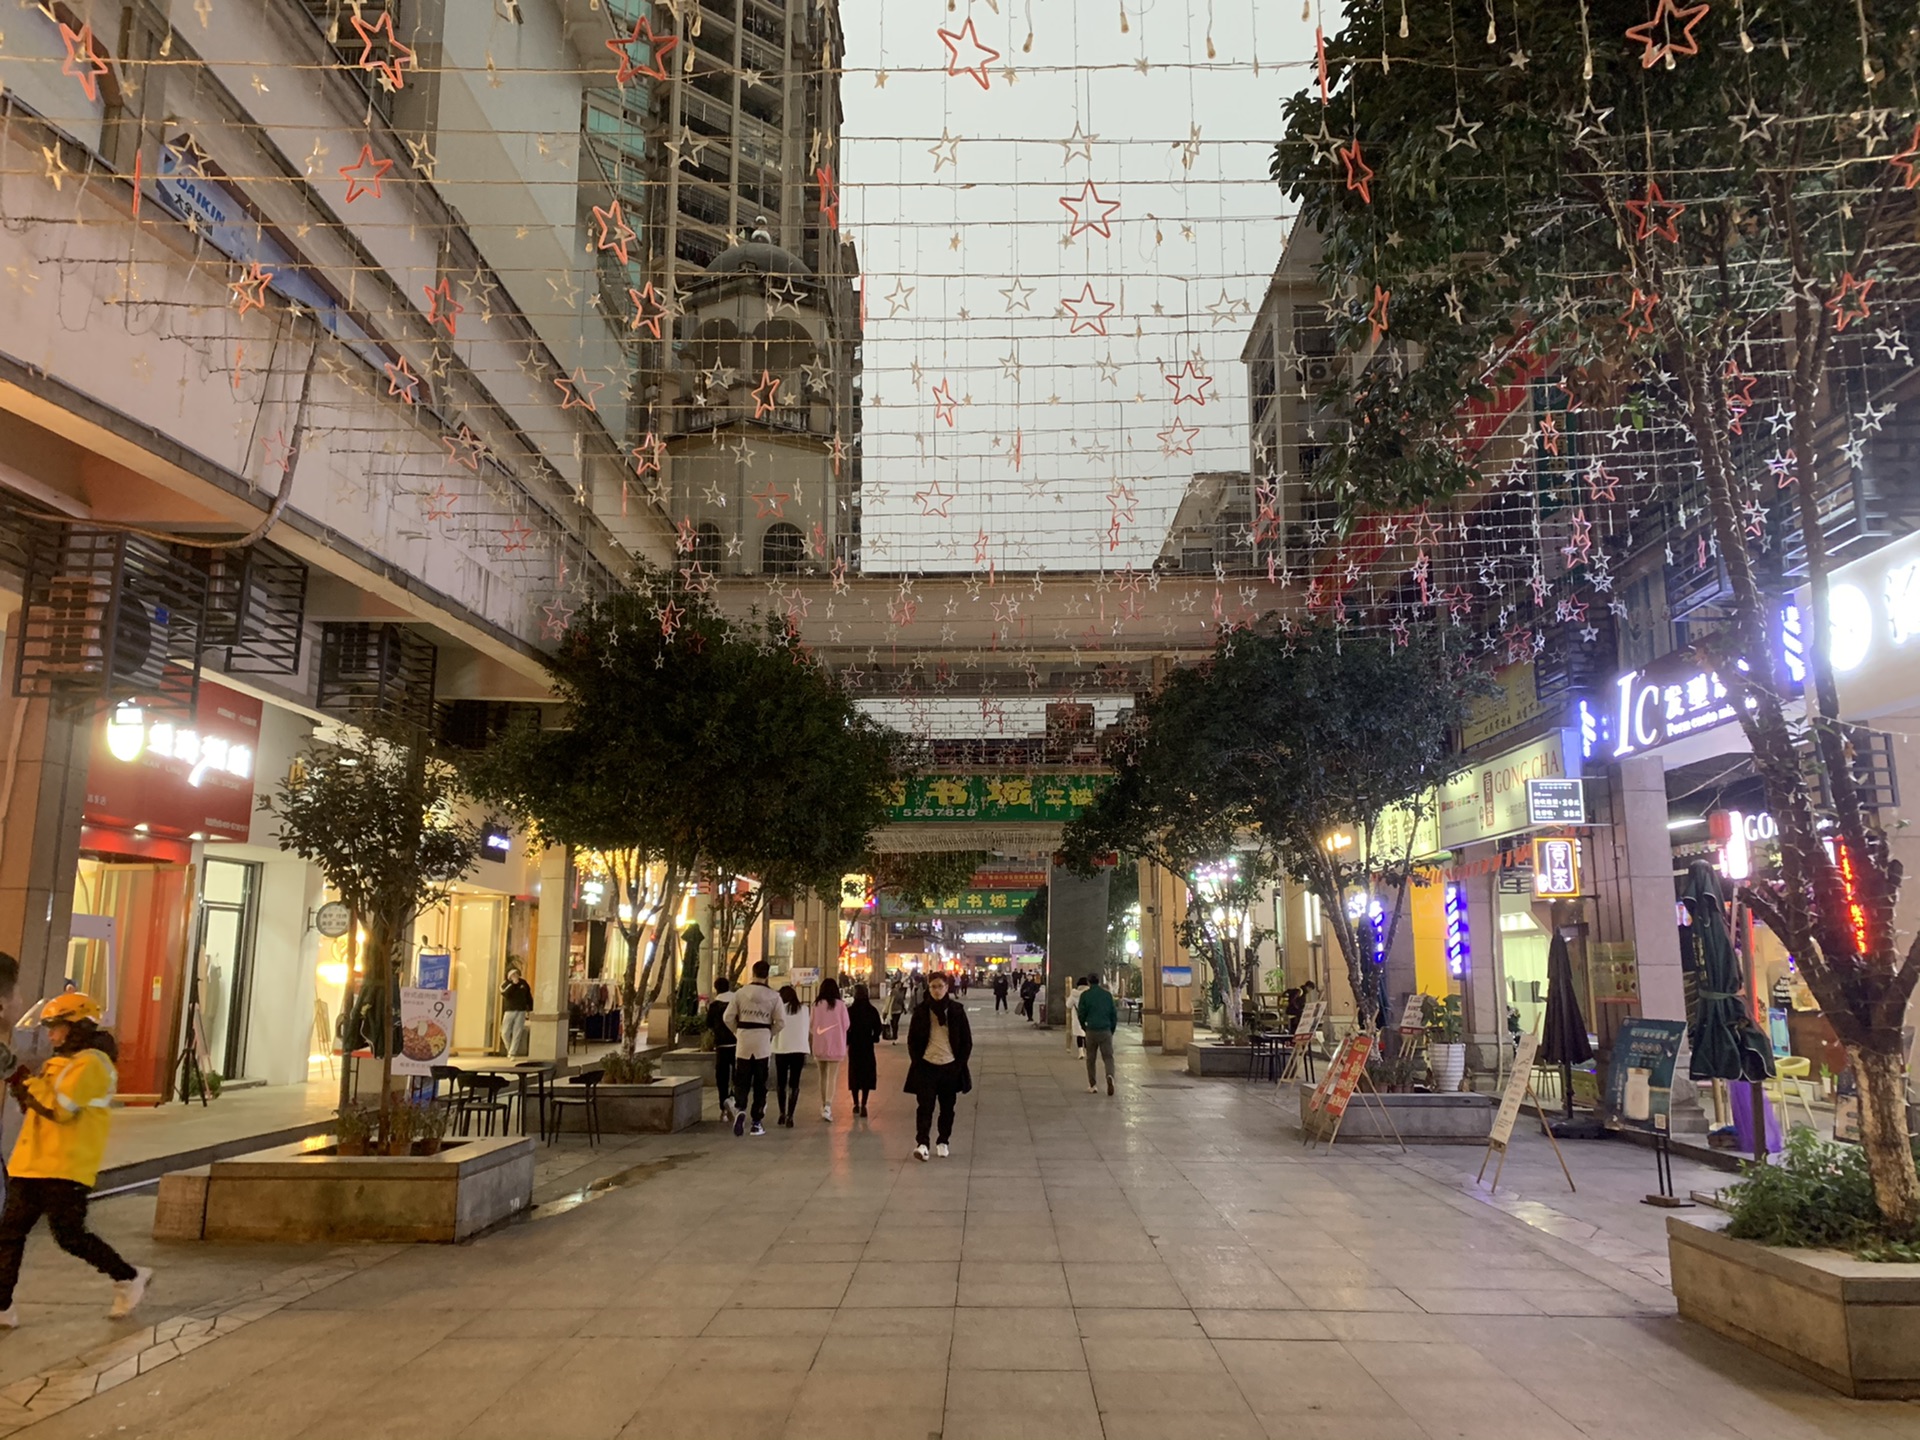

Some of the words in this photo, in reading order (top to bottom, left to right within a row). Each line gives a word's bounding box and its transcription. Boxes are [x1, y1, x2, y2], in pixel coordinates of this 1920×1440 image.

[176, 176, 225, 227] DAIKIN
[1494, 760, 1528, 794] GONG
[1531, 749, 1560, 780] CHA
[903, 808, 977, 817] 5287828
[1044, 788, 1094, 806] 二楼
